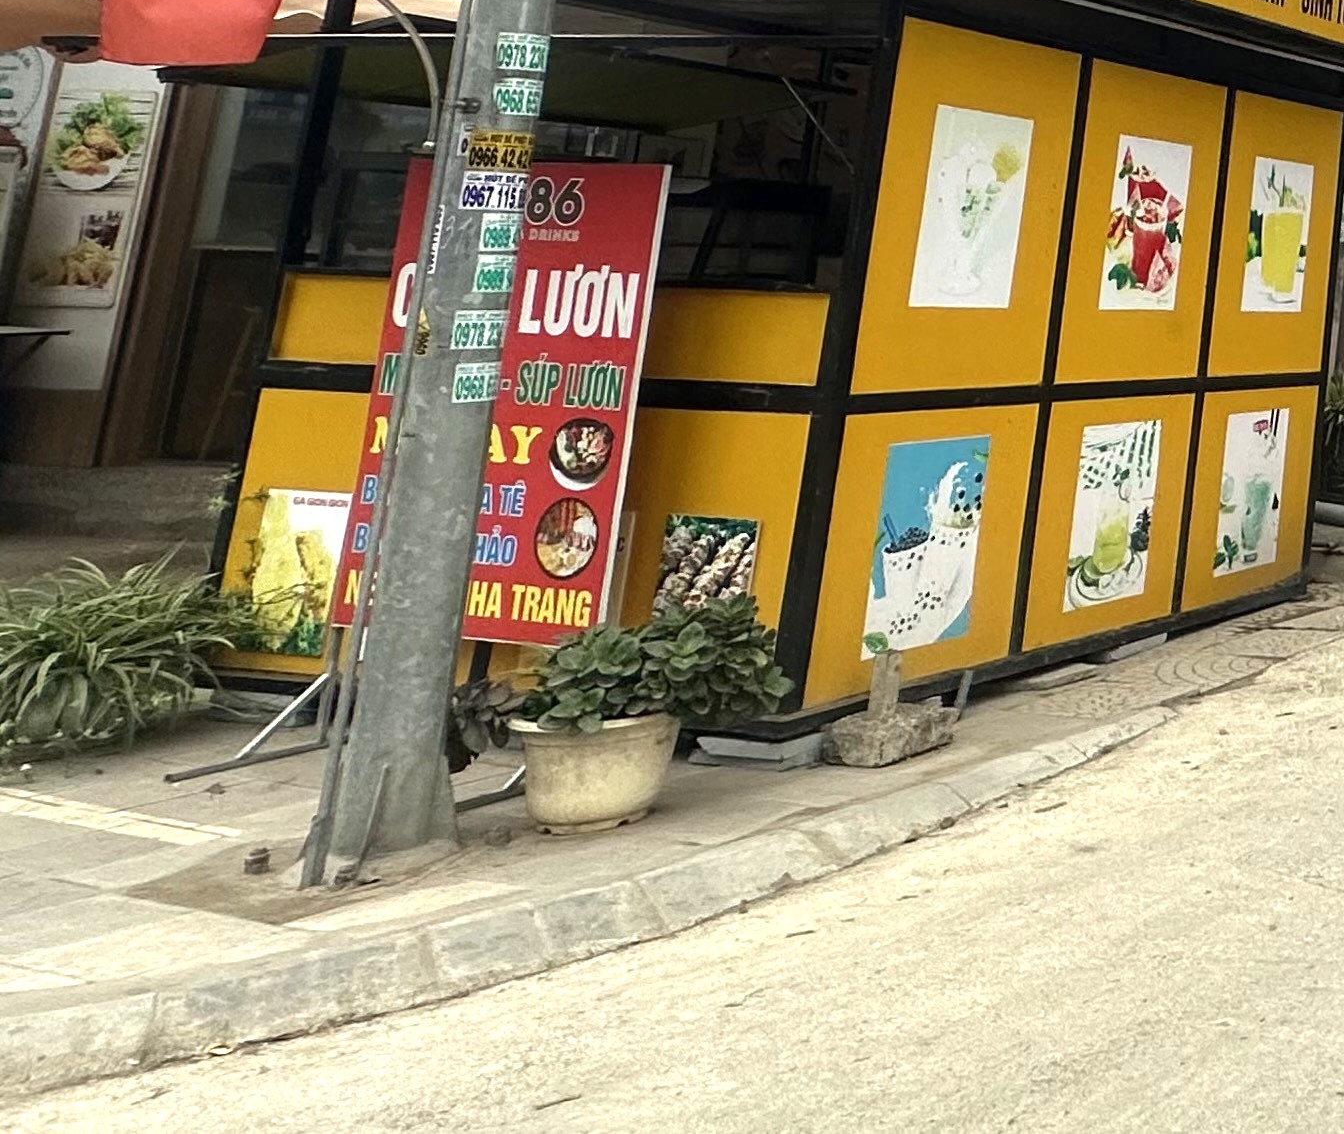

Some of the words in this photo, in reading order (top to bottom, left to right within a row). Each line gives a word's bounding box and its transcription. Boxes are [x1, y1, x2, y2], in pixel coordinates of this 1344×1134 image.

[514, 352, 561, 408] SÚP
[499, 479, 526, 517] TÊ
[511, 582, 592, 626] TRANG
